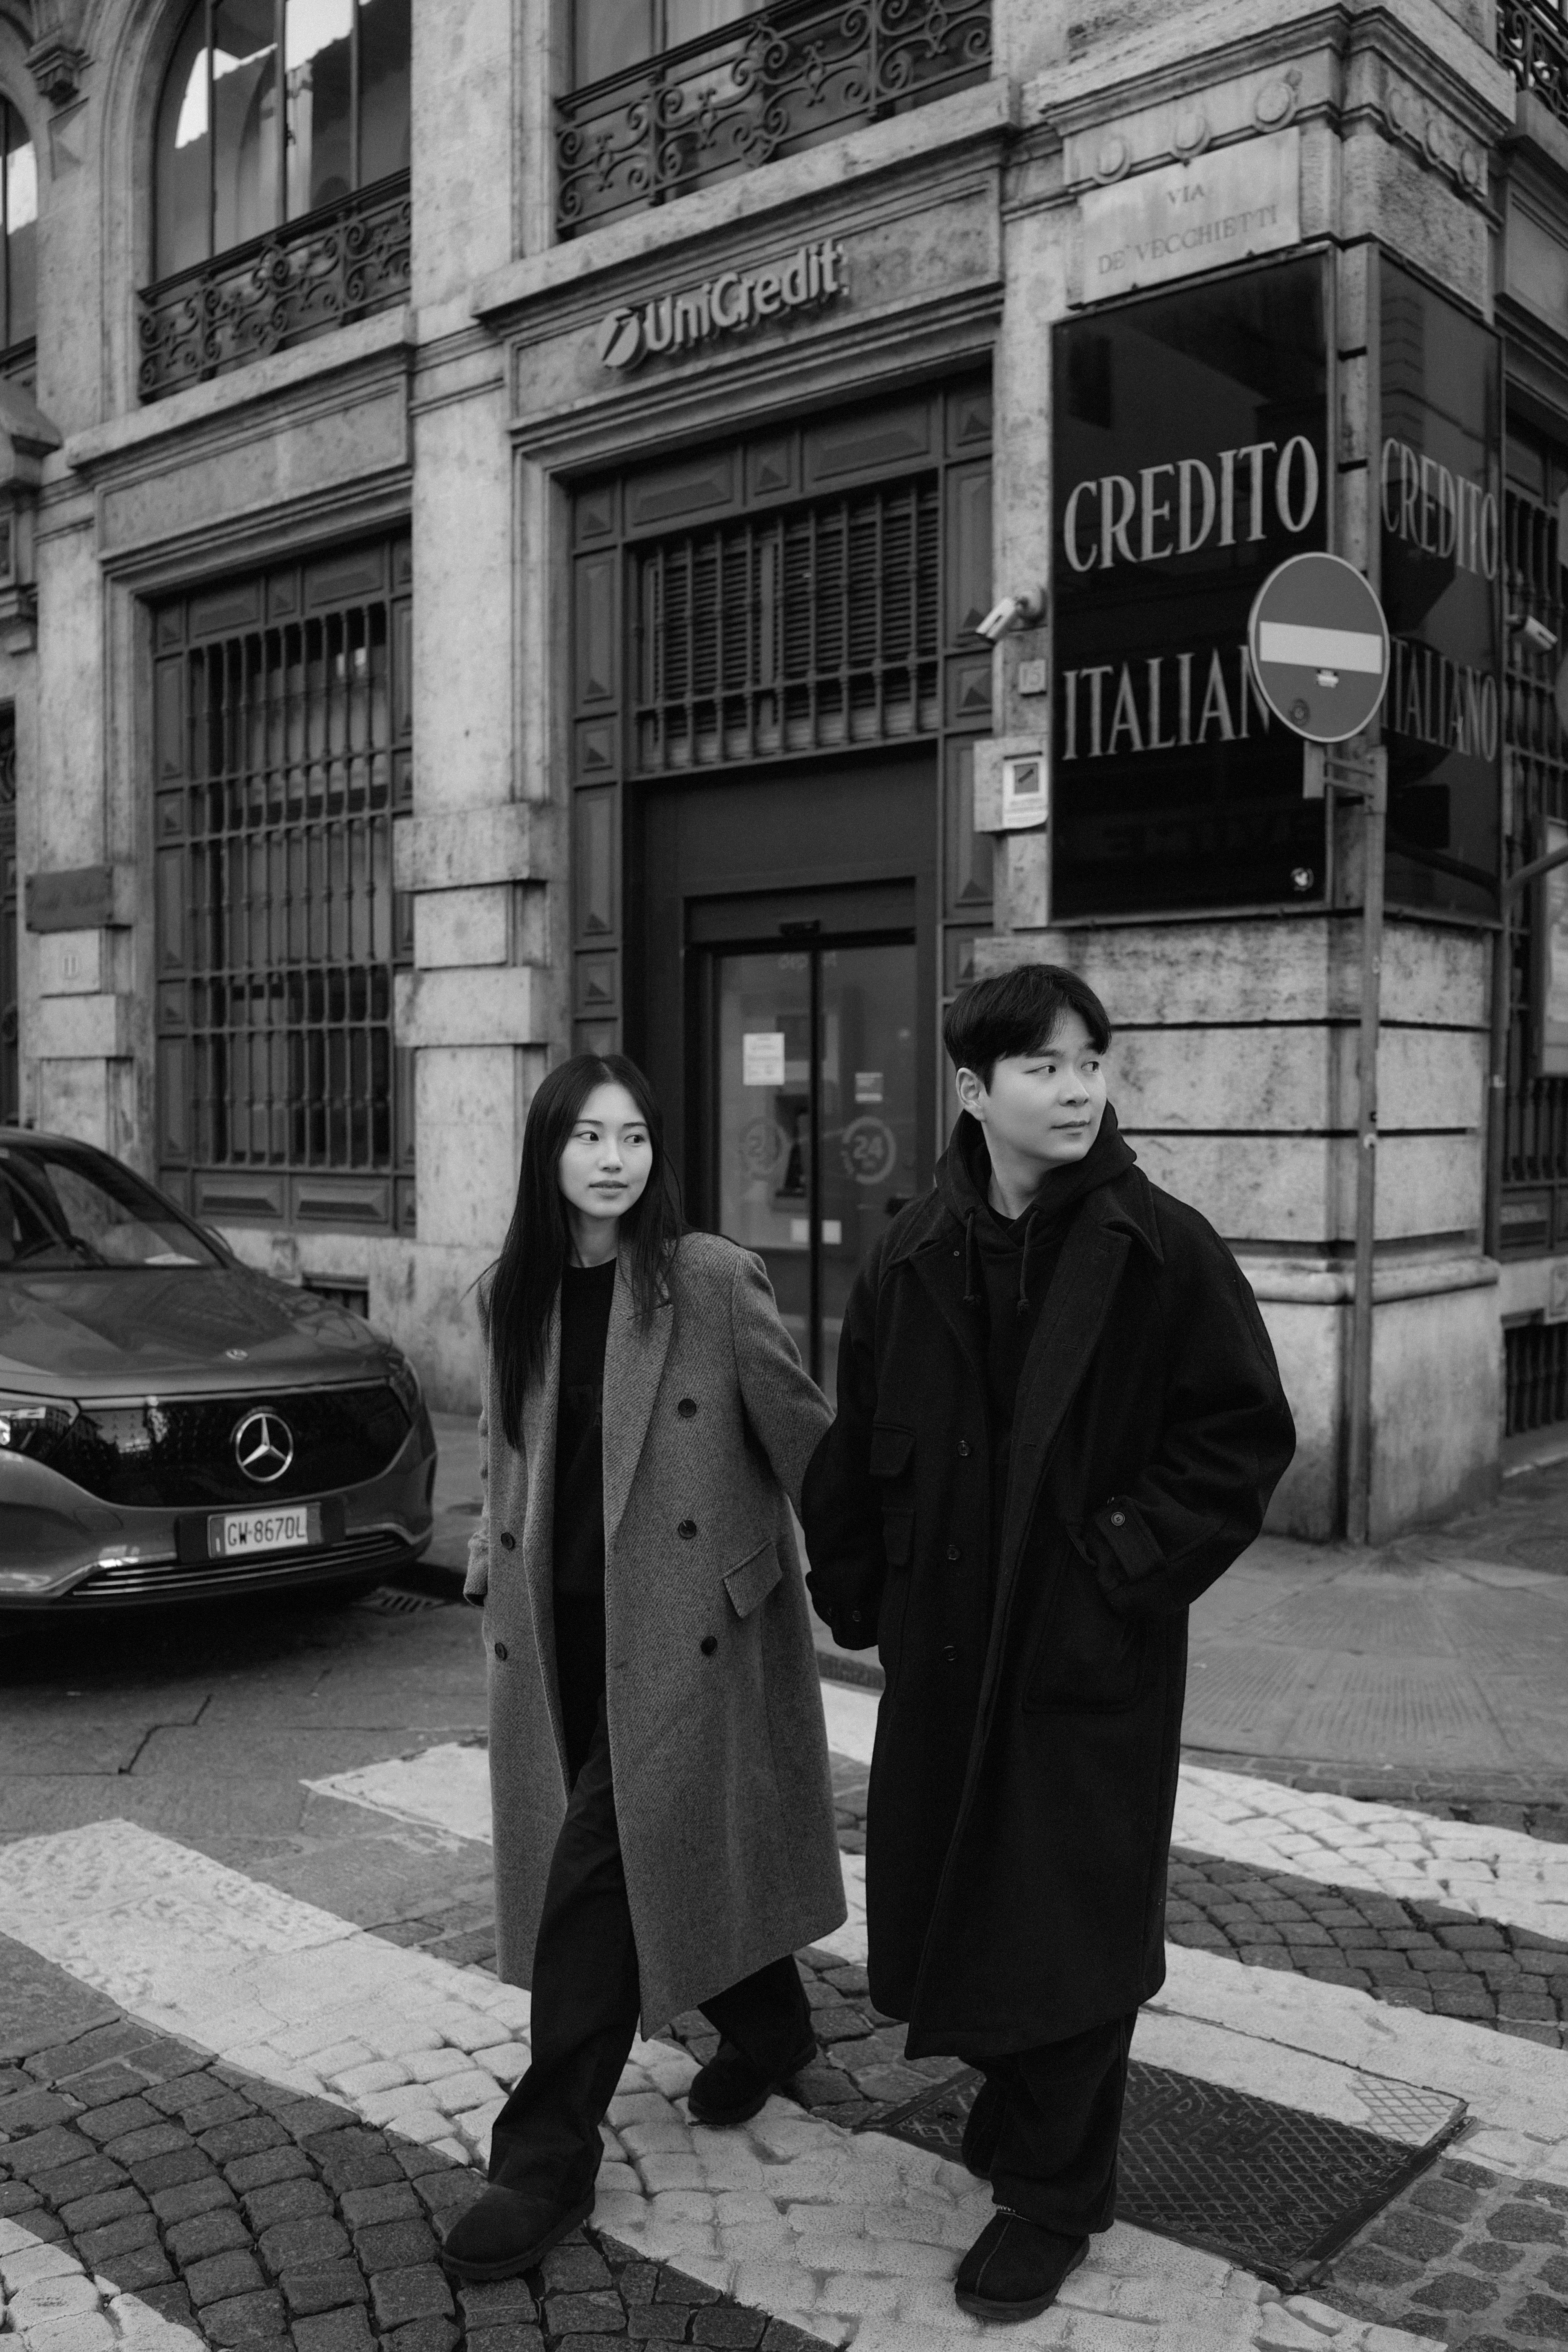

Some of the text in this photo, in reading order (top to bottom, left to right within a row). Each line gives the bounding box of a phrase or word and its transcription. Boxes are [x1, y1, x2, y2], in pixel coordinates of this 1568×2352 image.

[1134, 204, 1279, 262] VECCHIETTI
[1167, 183, 1205, 205] VIA
[644, 238, 844, 351] UniCredit
[1064, 435, 1319, 572] CREDITO
[1382, 438, 1499, 580] CREDITO
[1062, 645, 1270, 760] ITALIAN
[1382, 635, 1499, 762] TALIANO
